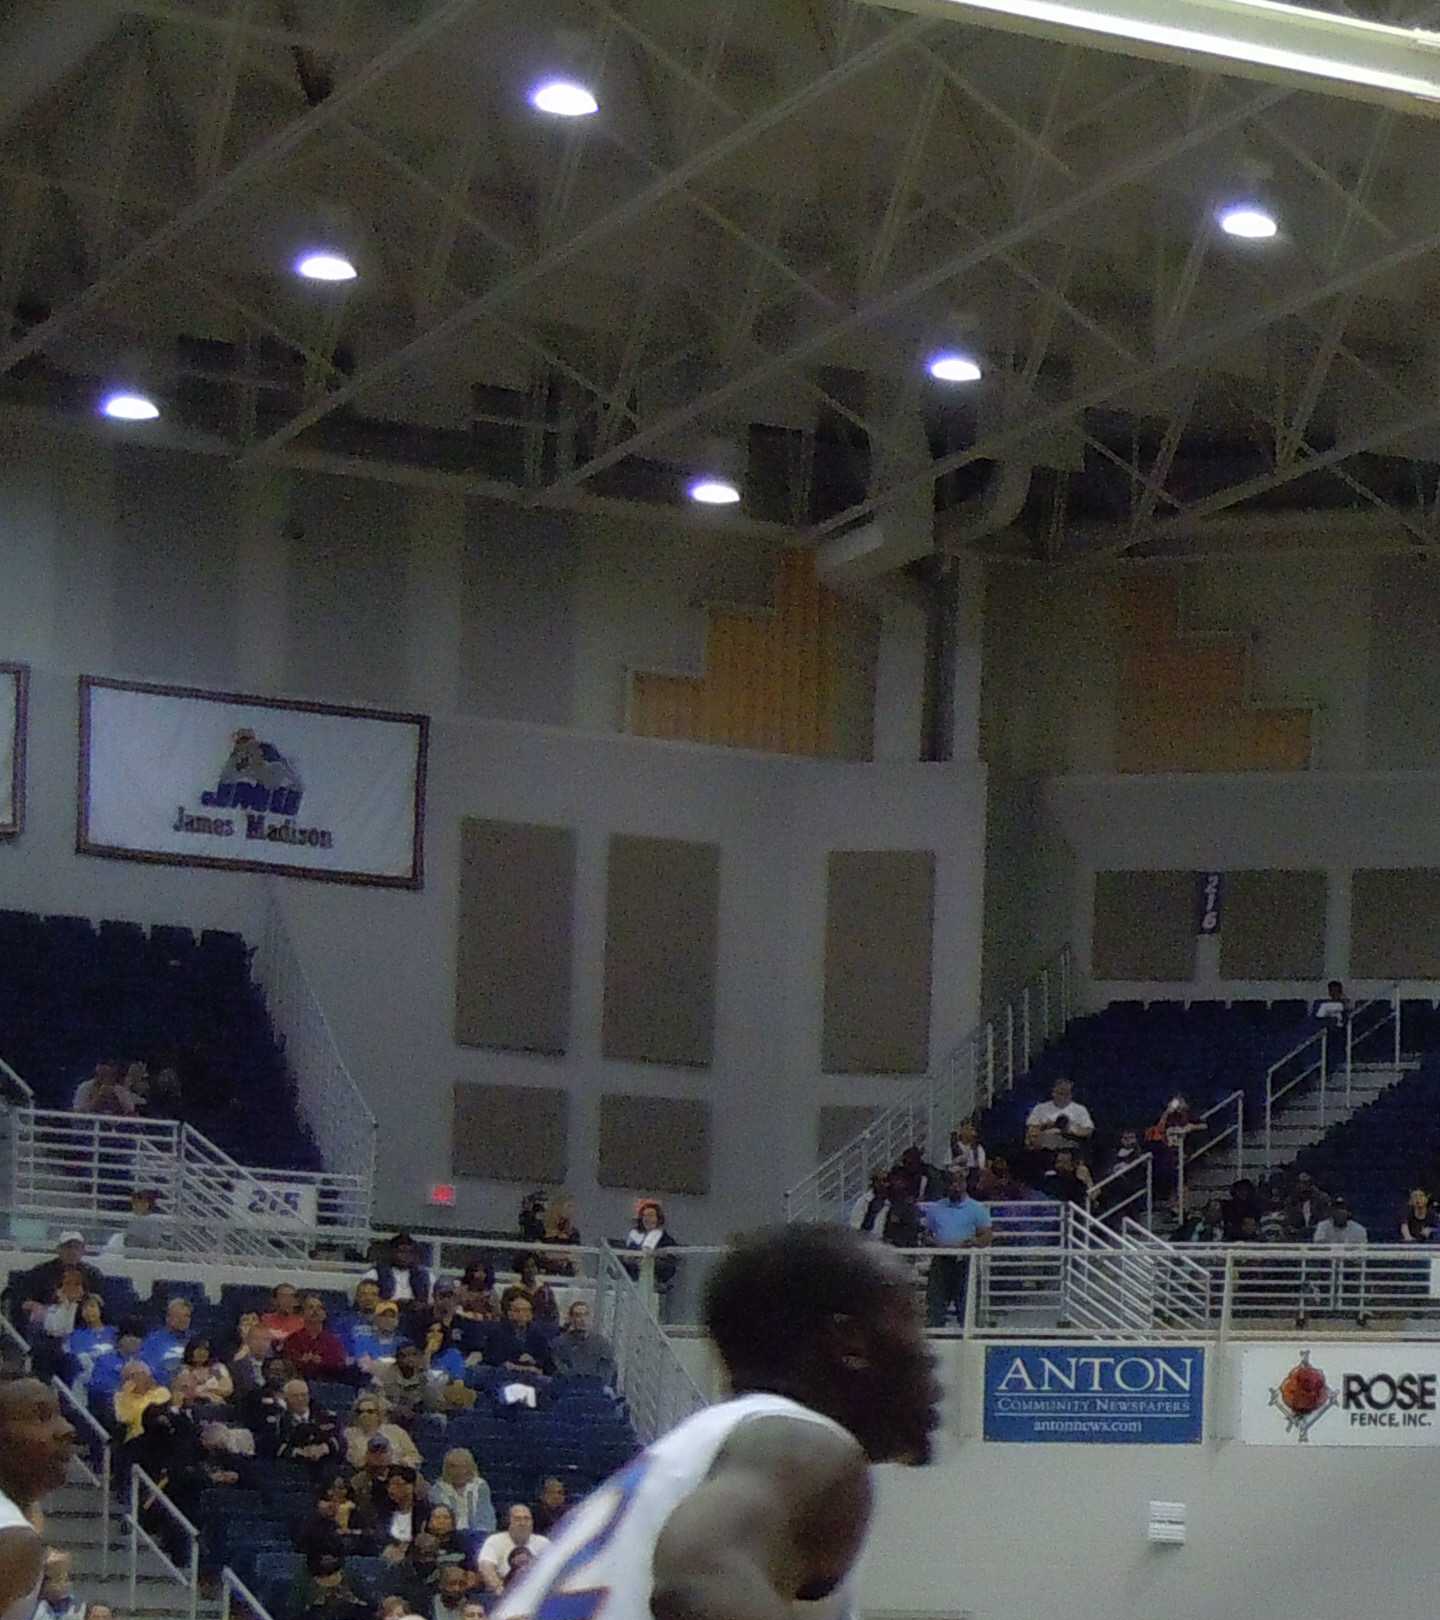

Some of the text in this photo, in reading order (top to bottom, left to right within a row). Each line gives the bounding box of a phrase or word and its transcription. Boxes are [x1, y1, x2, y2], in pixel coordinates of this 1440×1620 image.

[173, 806, 334, 848] James Madison
[1202, 875, 1219, 929] 216
[997, 1357, 1193, 1392] ANTON
[1342, 1373, 1437, 1410] ROSE
[998, 1399, 1190, 1412] COMMUNITY NEWSPAPERS
[1403, 1413, 1432, 1427] INC.
[1033, 1420, 1142, 1433] antonnews.com
